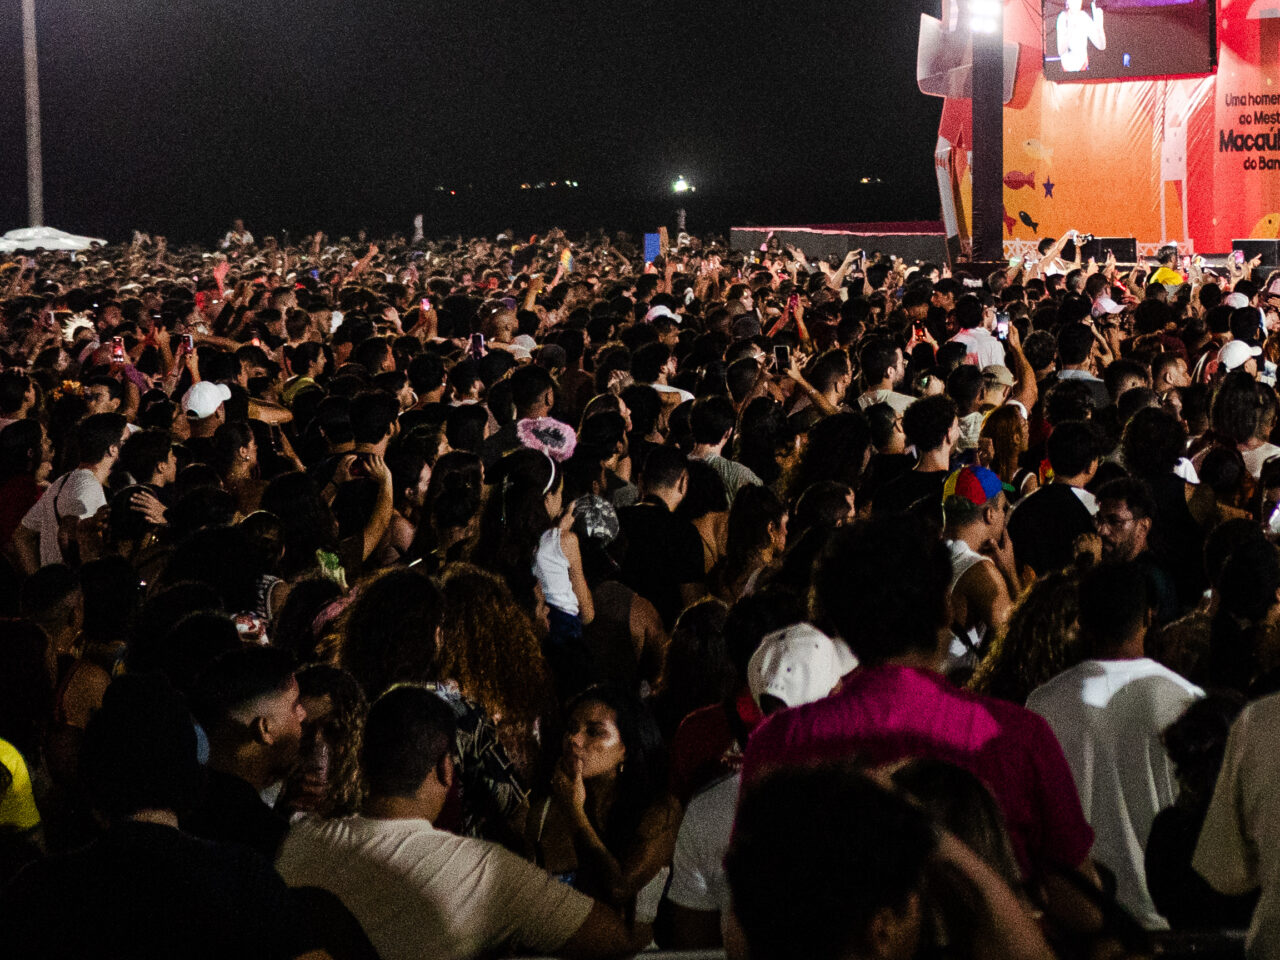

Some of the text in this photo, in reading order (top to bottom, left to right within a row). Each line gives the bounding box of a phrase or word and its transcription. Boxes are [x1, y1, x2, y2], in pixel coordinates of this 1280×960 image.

[1225, 93, 1247, 107] Uma
[1239, 114, 1252, 125] ao
[1243, 156, 1257, 170] do
